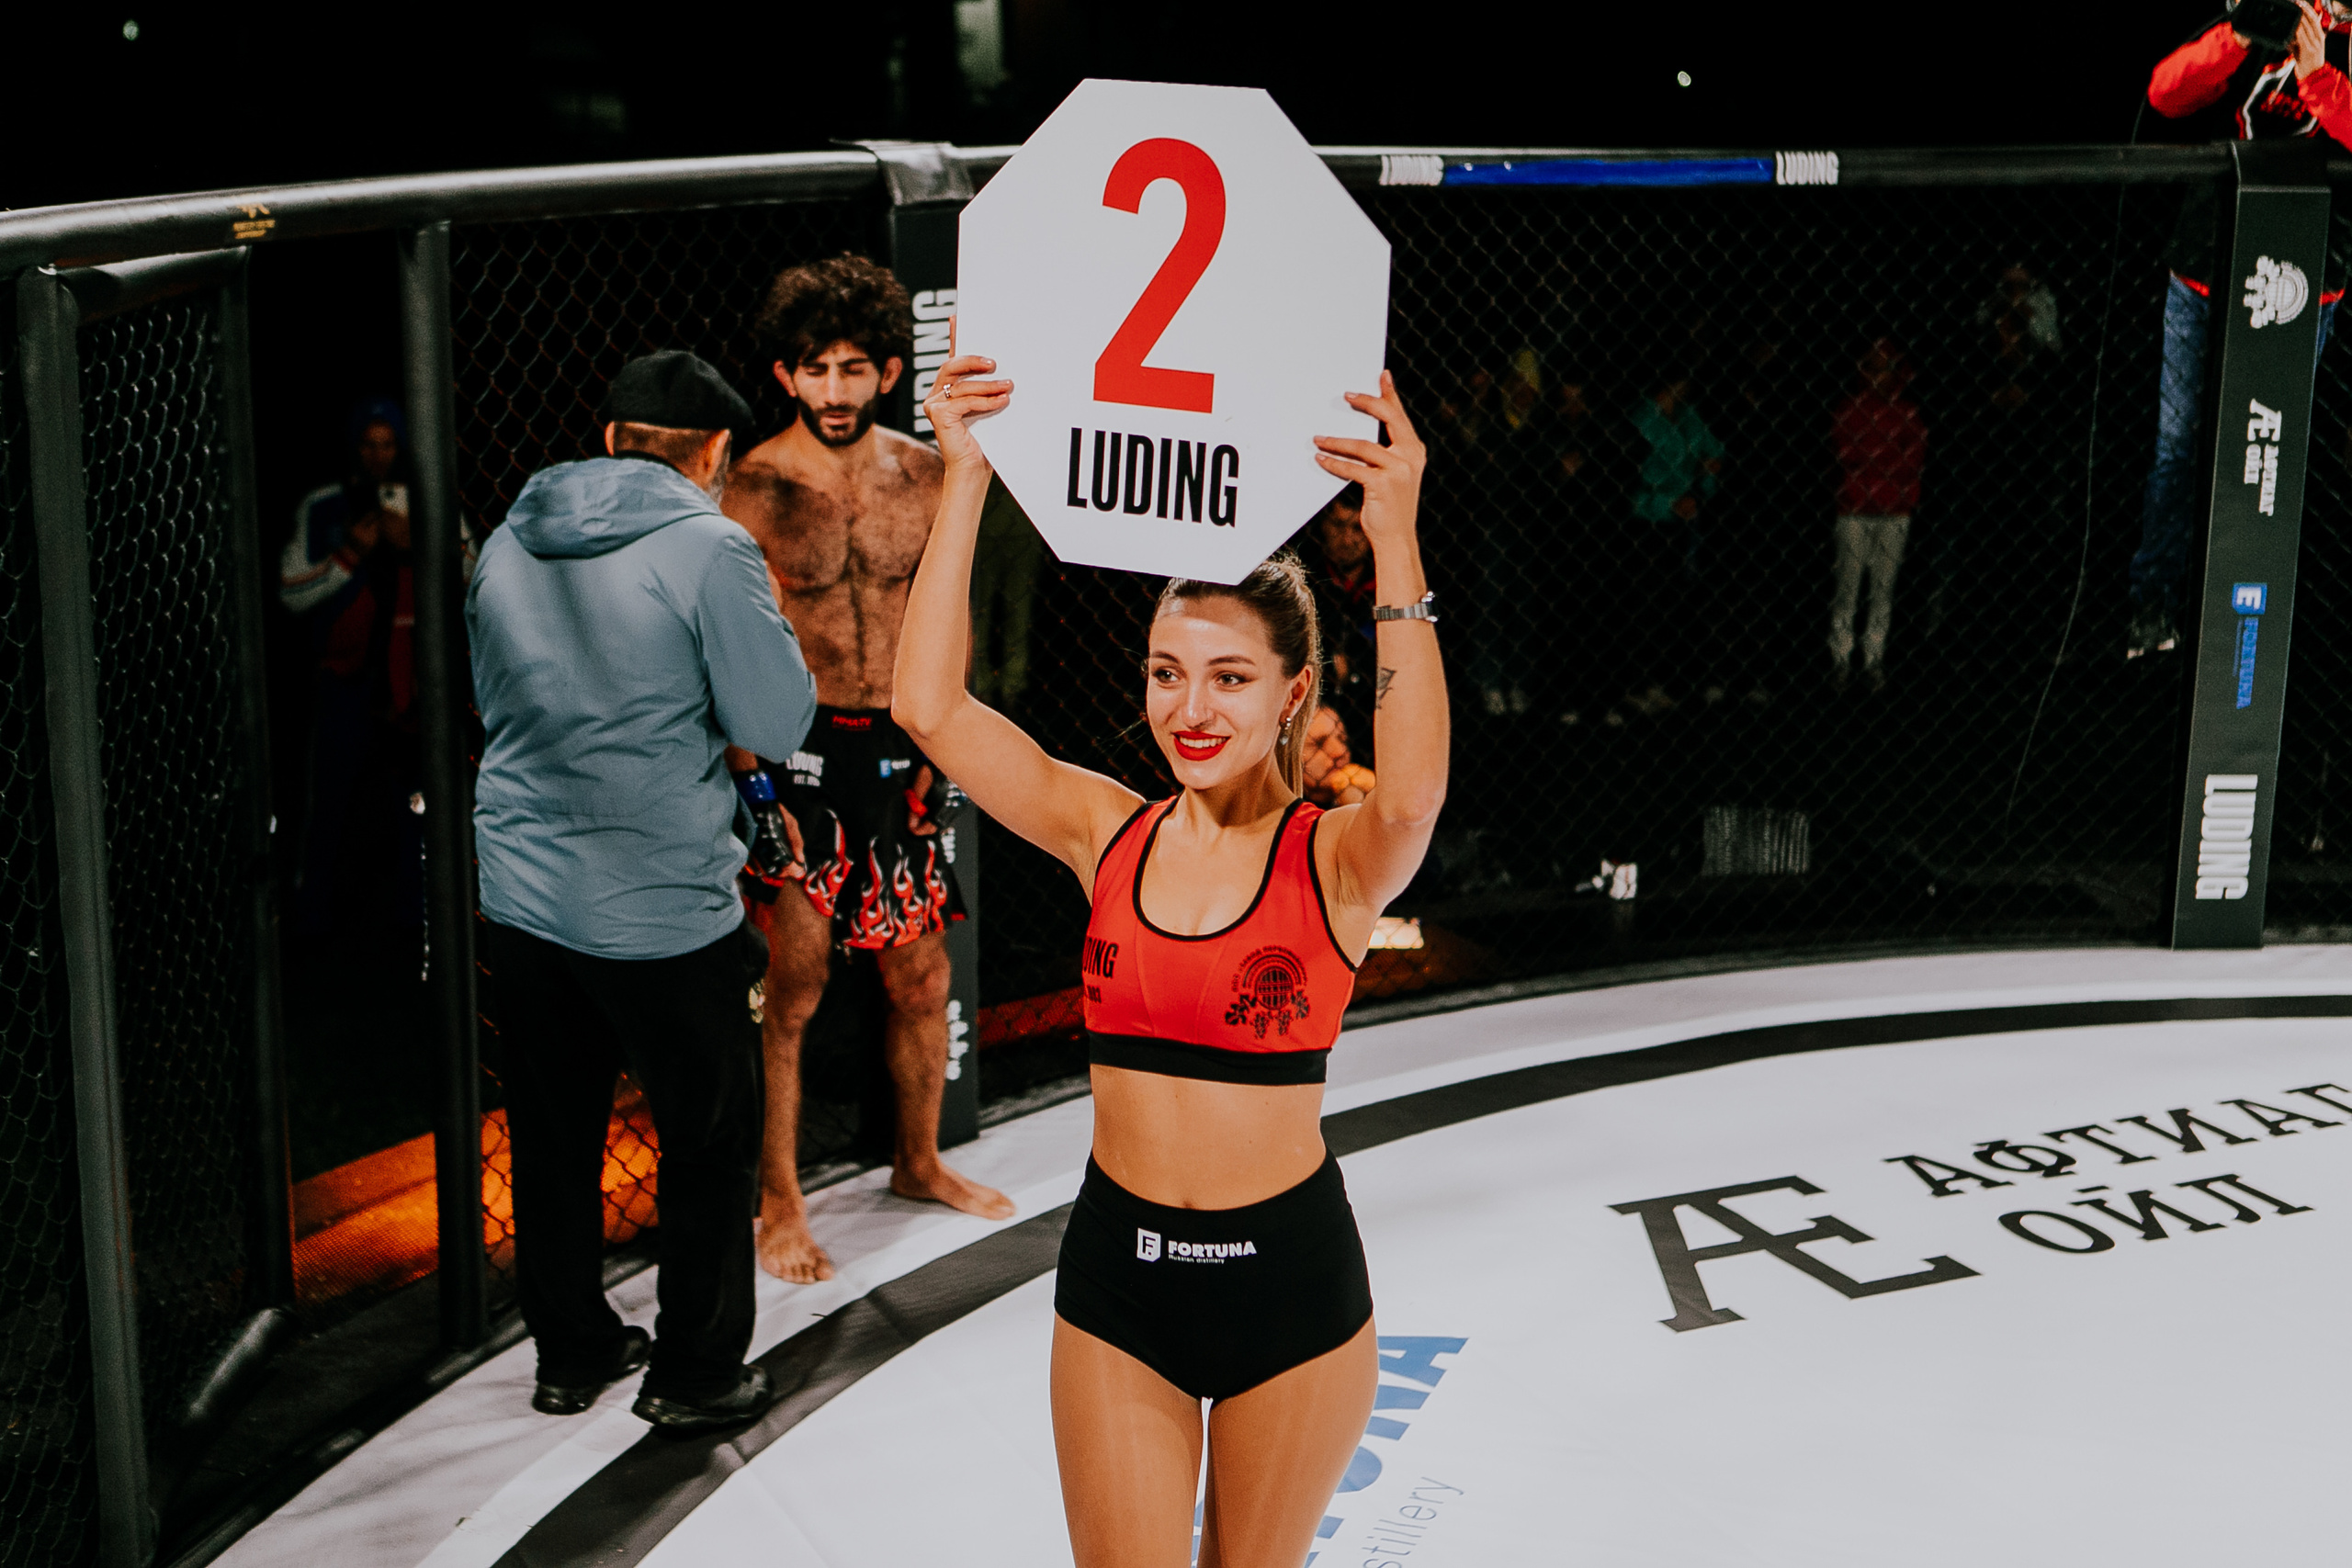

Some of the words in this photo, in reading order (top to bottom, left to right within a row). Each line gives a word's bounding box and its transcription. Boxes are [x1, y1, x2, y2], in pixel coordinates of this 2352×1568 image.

[1775, 151, 1839, 186] LUDING
[1093, 137, 1227, 414] 2
[1067, 426, 1239, 528] LUDING
[2195, 773, 2258, 900] LUDING
[1082, 936, 1119, 979] DING
[1168, 1240, 1257, 1258] FORTUNA
[1997, 1173, 2316, 1255] ОЙЛ
